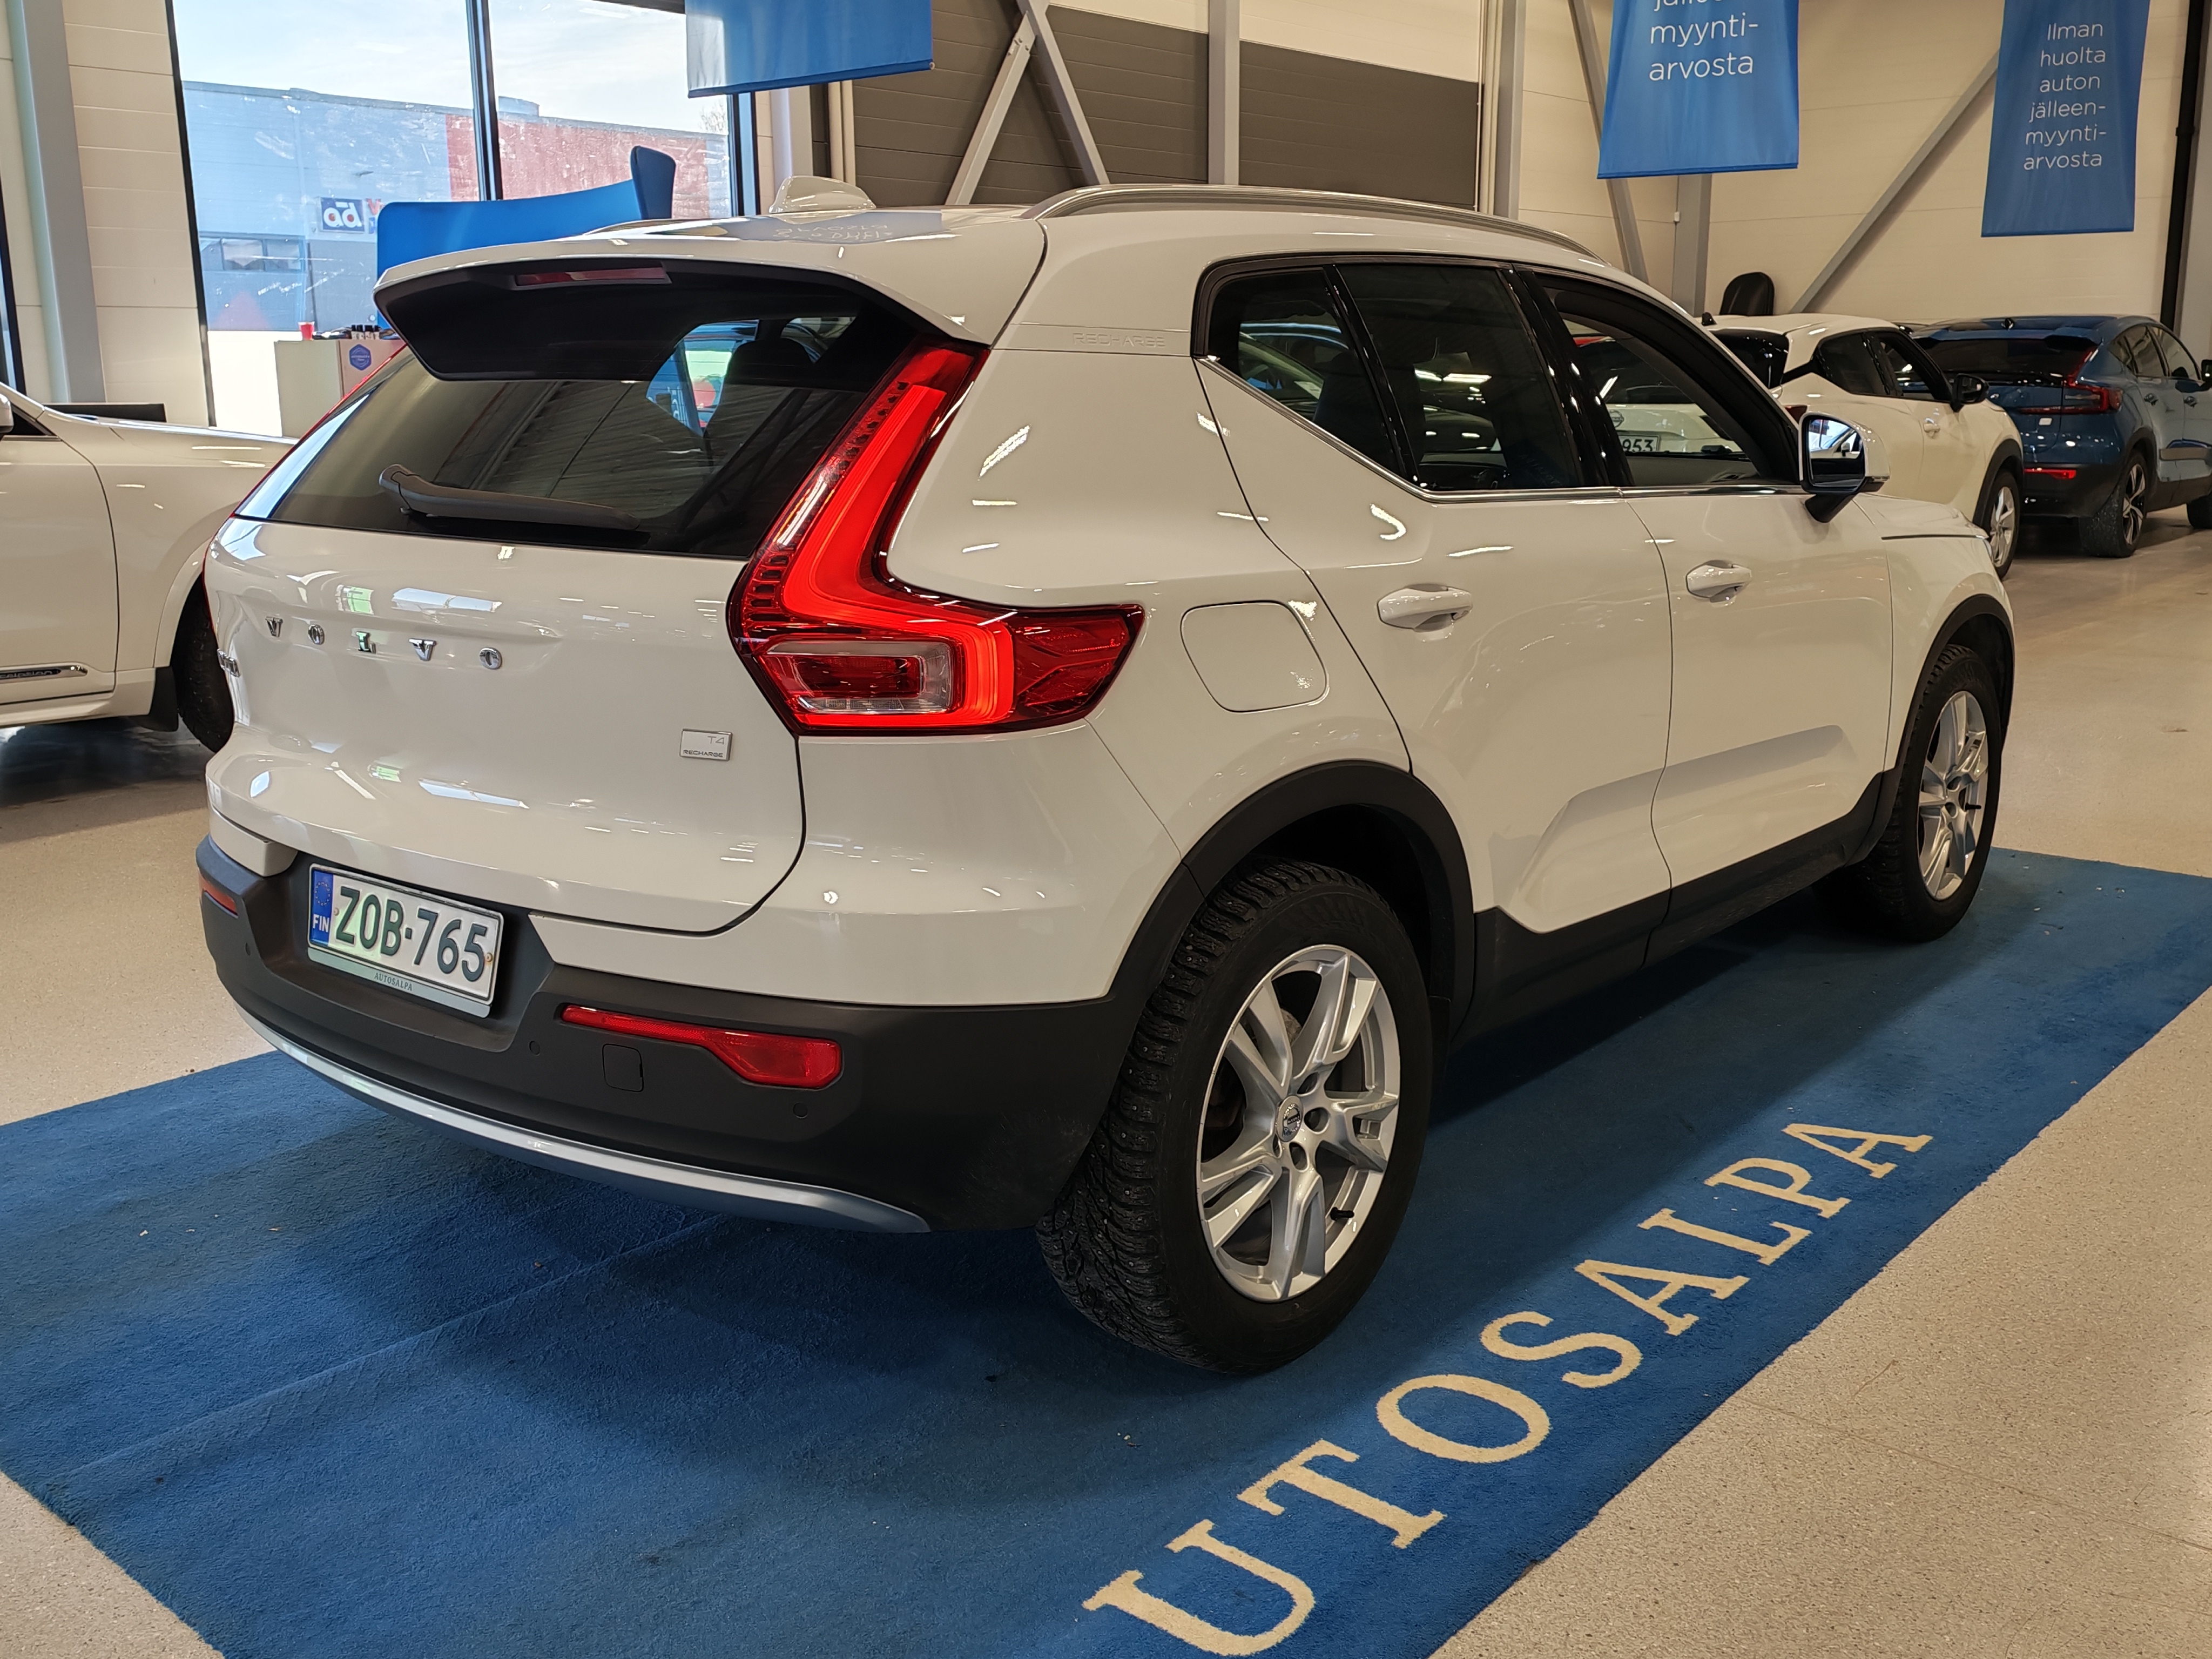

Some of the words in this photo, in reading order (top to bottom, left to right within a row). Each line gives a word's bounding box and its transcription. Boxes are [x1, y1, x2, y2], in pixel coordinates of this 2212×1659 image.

[1650, 12, 1758, 47] myynti-
[2047, 23, 2103, 41] Ilman
[1649, 52, 1754, 81] arvosta
[2040, 46, 2106, 68] huolta
[2039, 75, 2100, 92] auton
[2029, 100, 2106, 123] jälleen-
[2026, 124, 2106, 147] myynti-
[2024, 151, 2102, 170] arvosta
[1073, 333, 1166, 348] RECHARGE
[265, 616, 502, 670] VOLVO
[707, 736, 725, 745] T4
[683, 749, 724, 758] RECHARGE
[313, 914, 330, 933] FIN
[336, 886, 488, 982] ZOB-765
[374, 972, 413, 992] AUTOSALPA
[1083, 1123, 1933, 1656] UTOSALPA
